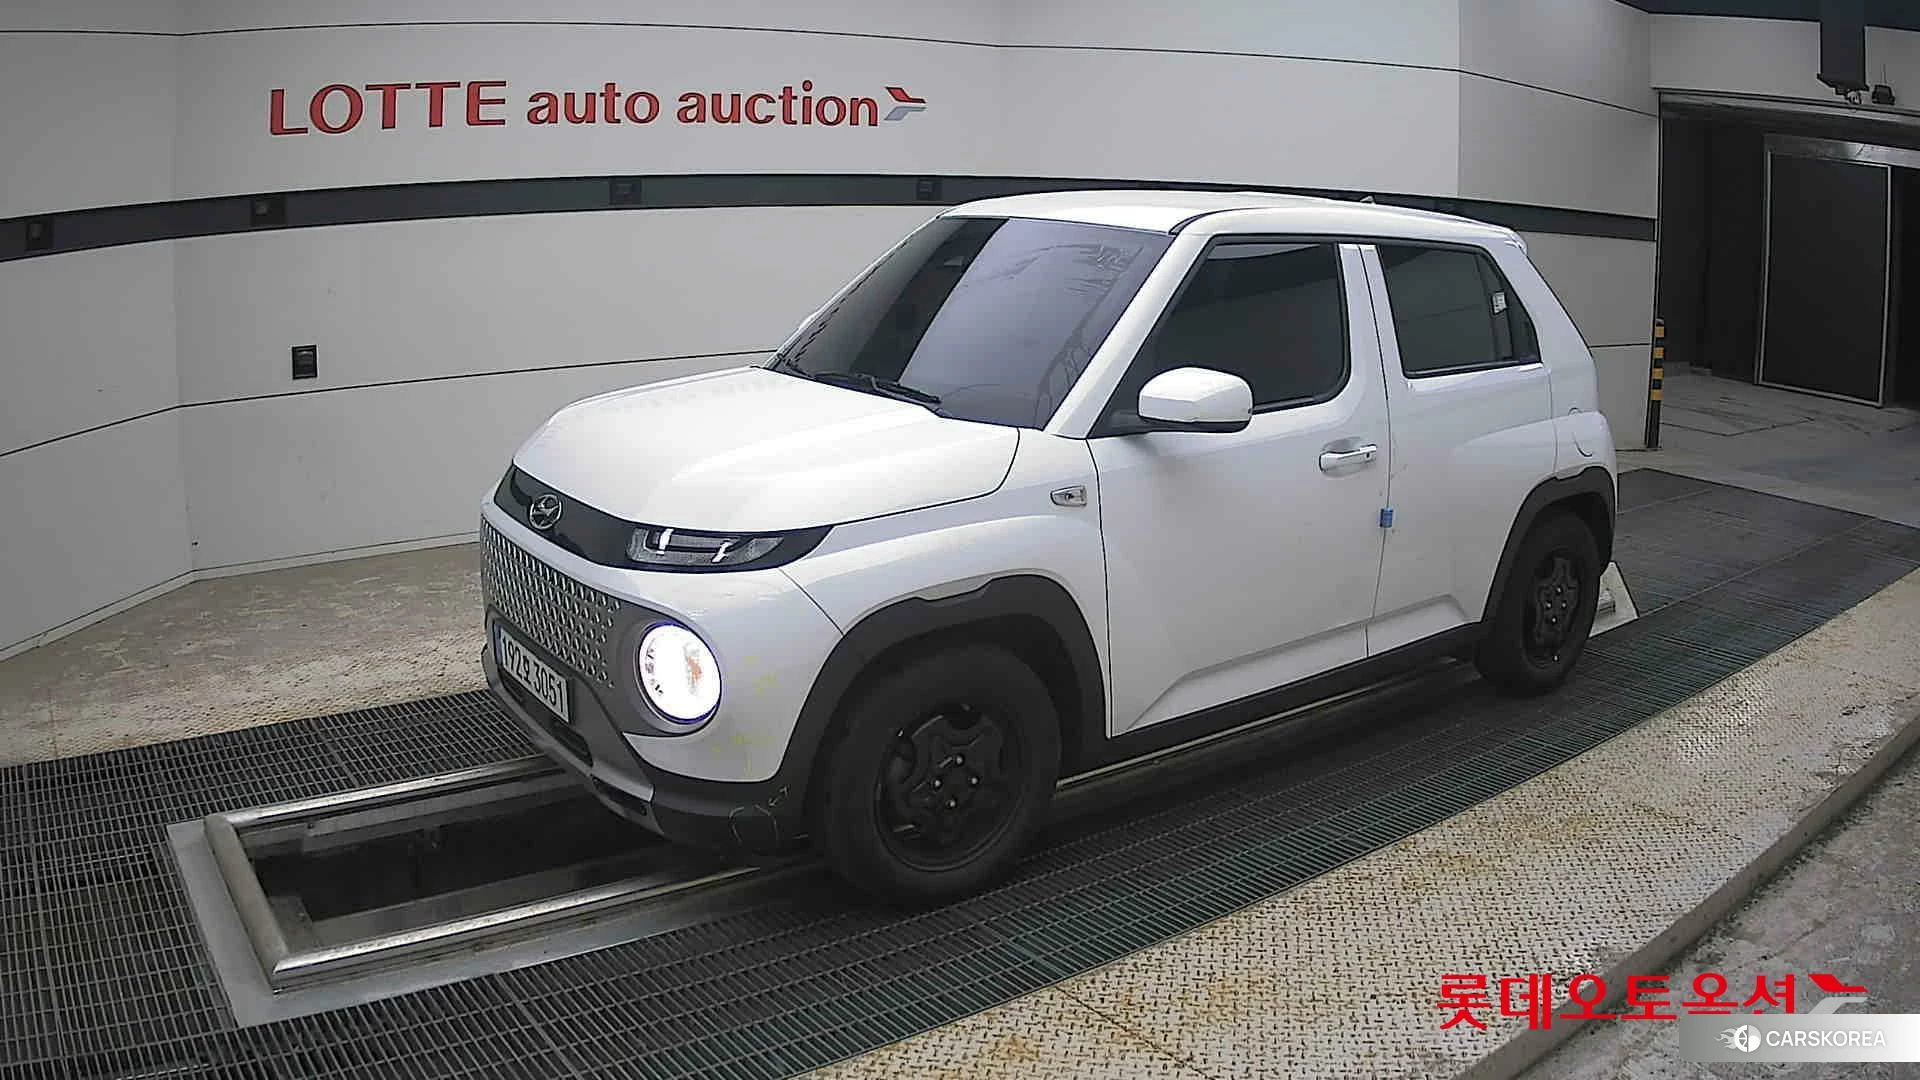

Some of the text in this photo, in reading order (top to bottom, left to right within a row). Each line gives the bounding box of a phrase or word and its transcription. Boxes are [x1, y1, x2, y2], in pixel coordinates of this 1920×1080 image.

[269, 80, 879, 135] LOTTE auto auction
[533, 660, 564, 713] 3051
